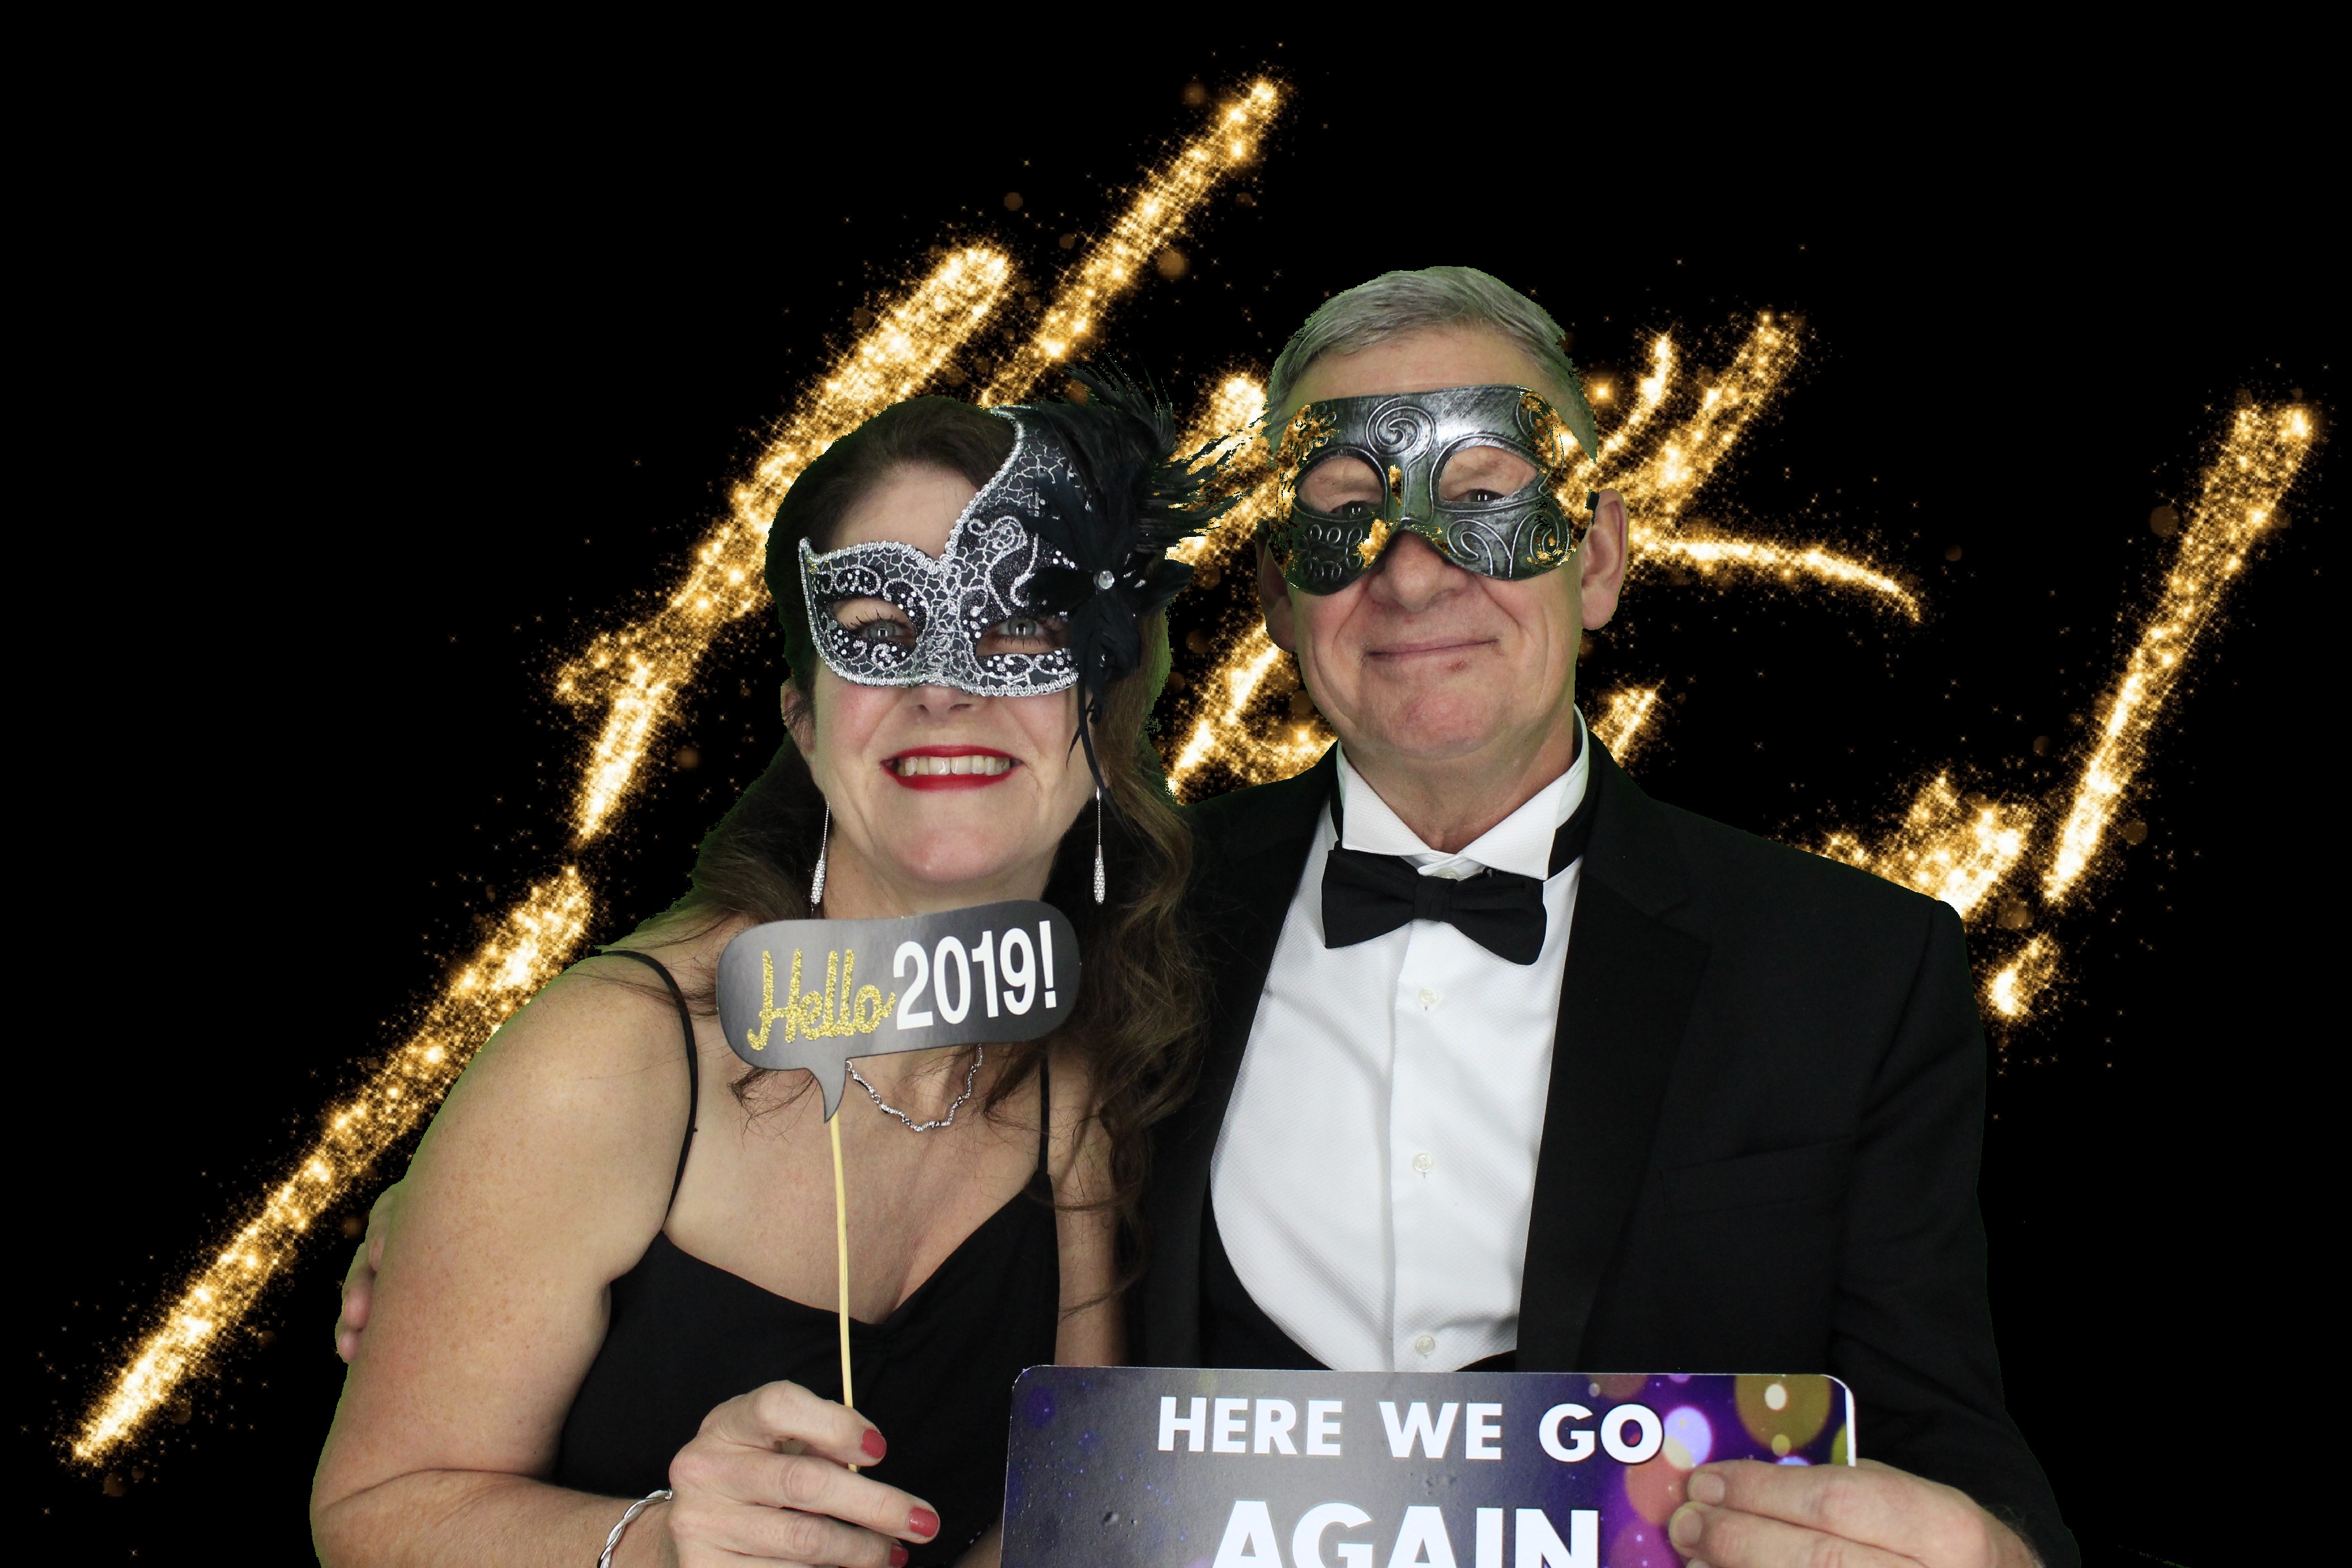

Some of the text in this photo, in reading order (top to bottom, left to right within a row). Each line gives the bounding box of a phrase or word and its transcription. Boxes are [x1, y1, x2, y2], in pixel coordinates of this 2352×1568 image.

[747, 920, 1057, 1051] Hello 2019!
[1157, 1396, 1664, 1463] HERE WE GO
[1212, 1500, 1598, 1568] AGAIN
